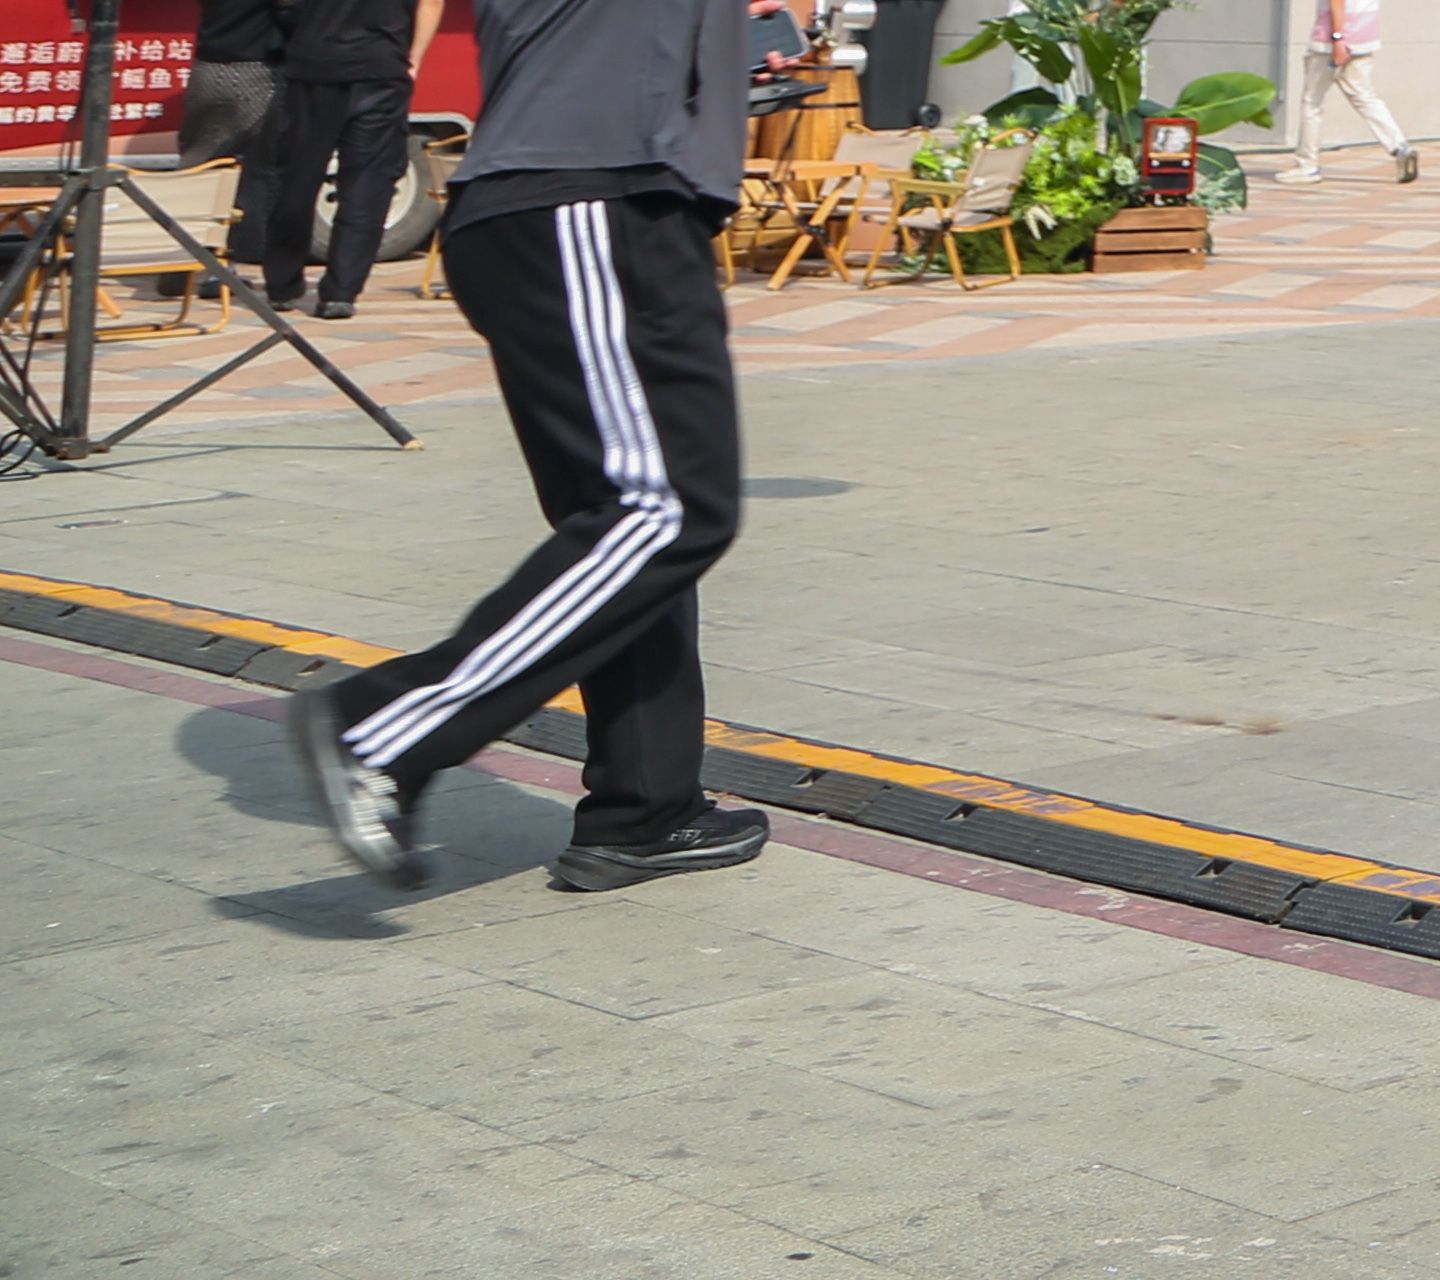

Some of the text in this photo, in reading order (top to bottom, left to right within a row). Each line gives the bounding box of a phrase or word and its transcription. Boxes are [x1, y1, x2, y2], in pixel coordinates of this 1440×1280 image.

[0, 40, 194, 66] 邂逅蔚补给站
